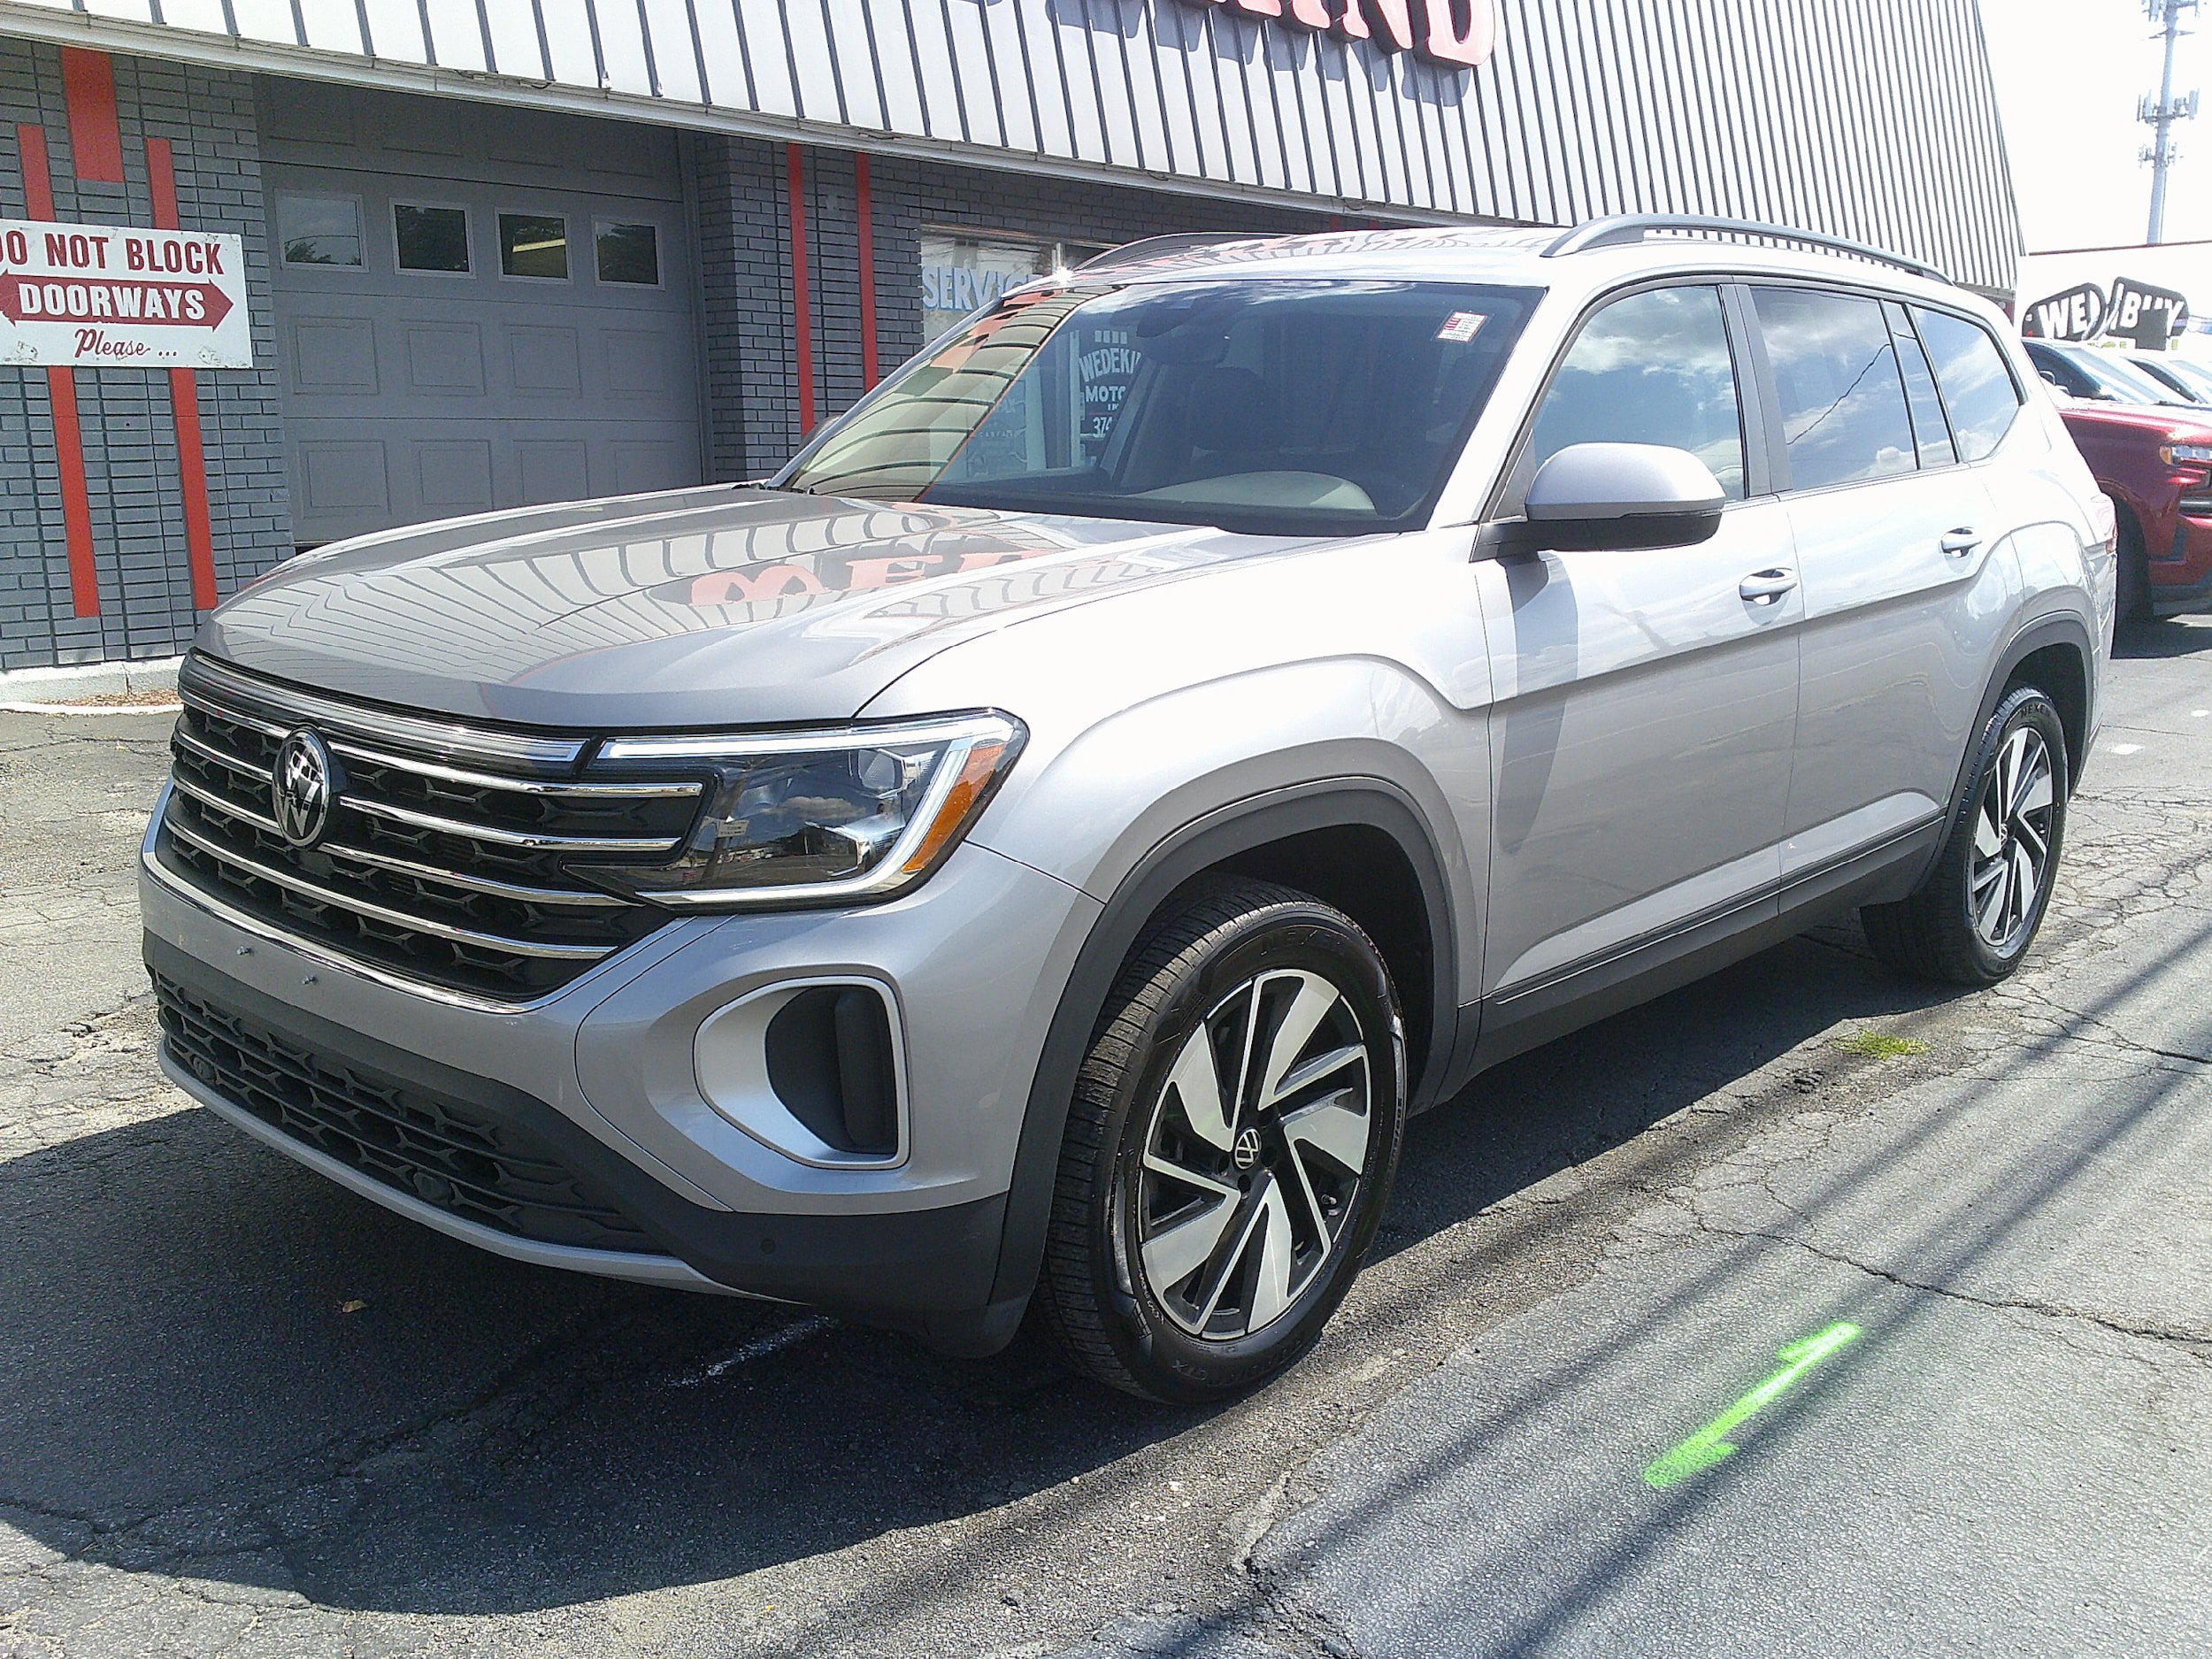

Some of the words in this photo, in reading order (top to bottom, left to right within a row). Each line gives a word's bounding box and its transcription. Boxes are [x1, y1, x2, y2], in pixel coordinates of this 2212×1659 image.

[0, 230, 27, 265] O
[44, 233, 109, 269] NOT
[126, 238, 225, 275] BLOCK
[18, 282, 206, 320] DOORWAYS
[922, 266, 1043, 311] SERVI
[73, 328, 151, 358] Please
